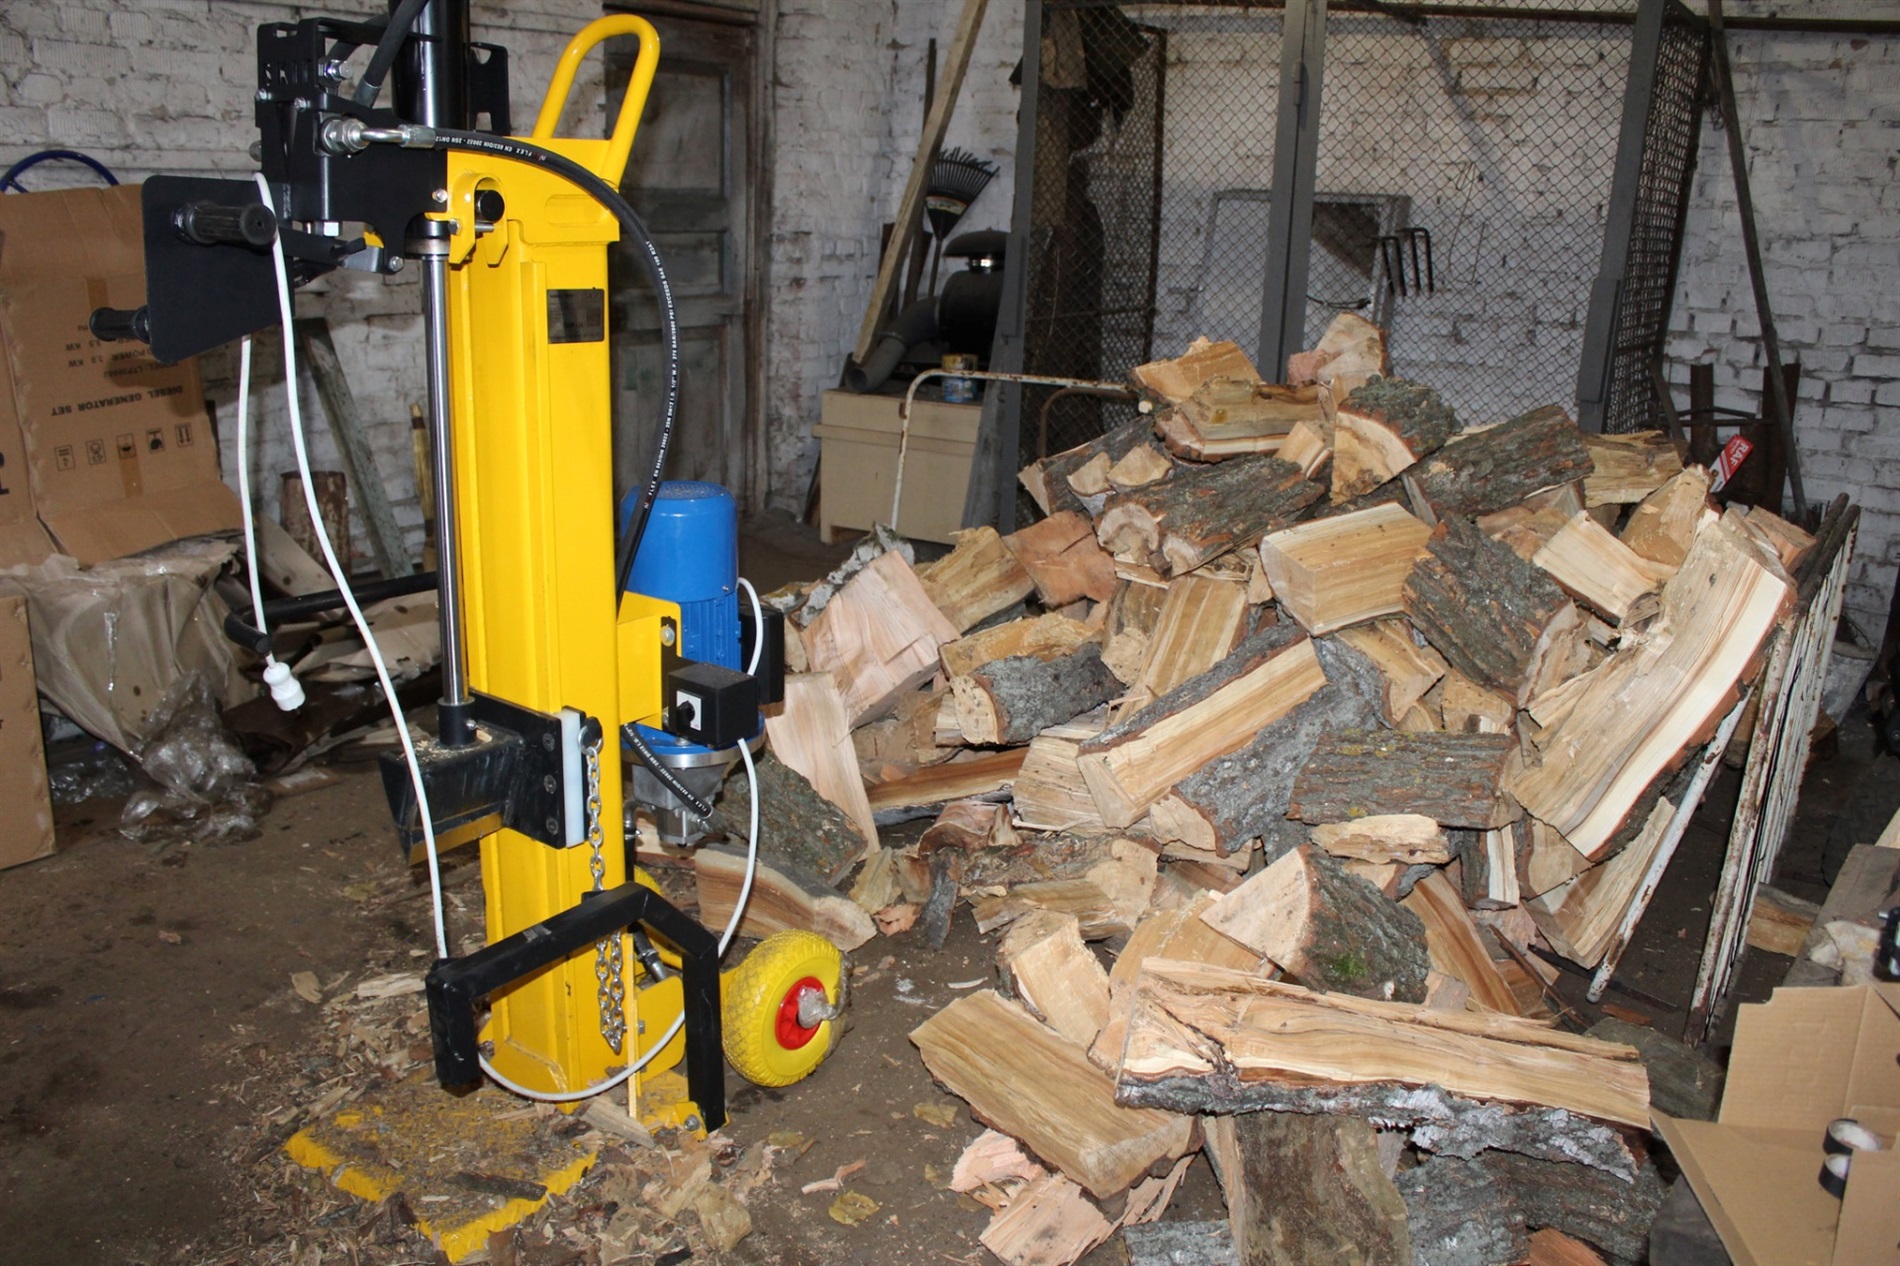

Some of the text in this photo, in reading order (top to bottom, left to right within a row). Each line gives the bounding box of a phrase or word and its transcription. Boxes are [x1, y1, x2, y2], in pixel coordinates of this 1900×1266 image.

[657, 267, 666, 279] SAE
[662, 280, 673, 308] EXCEEDS
[50, 385, 183, 417] DIESEL GENERATOR SET
